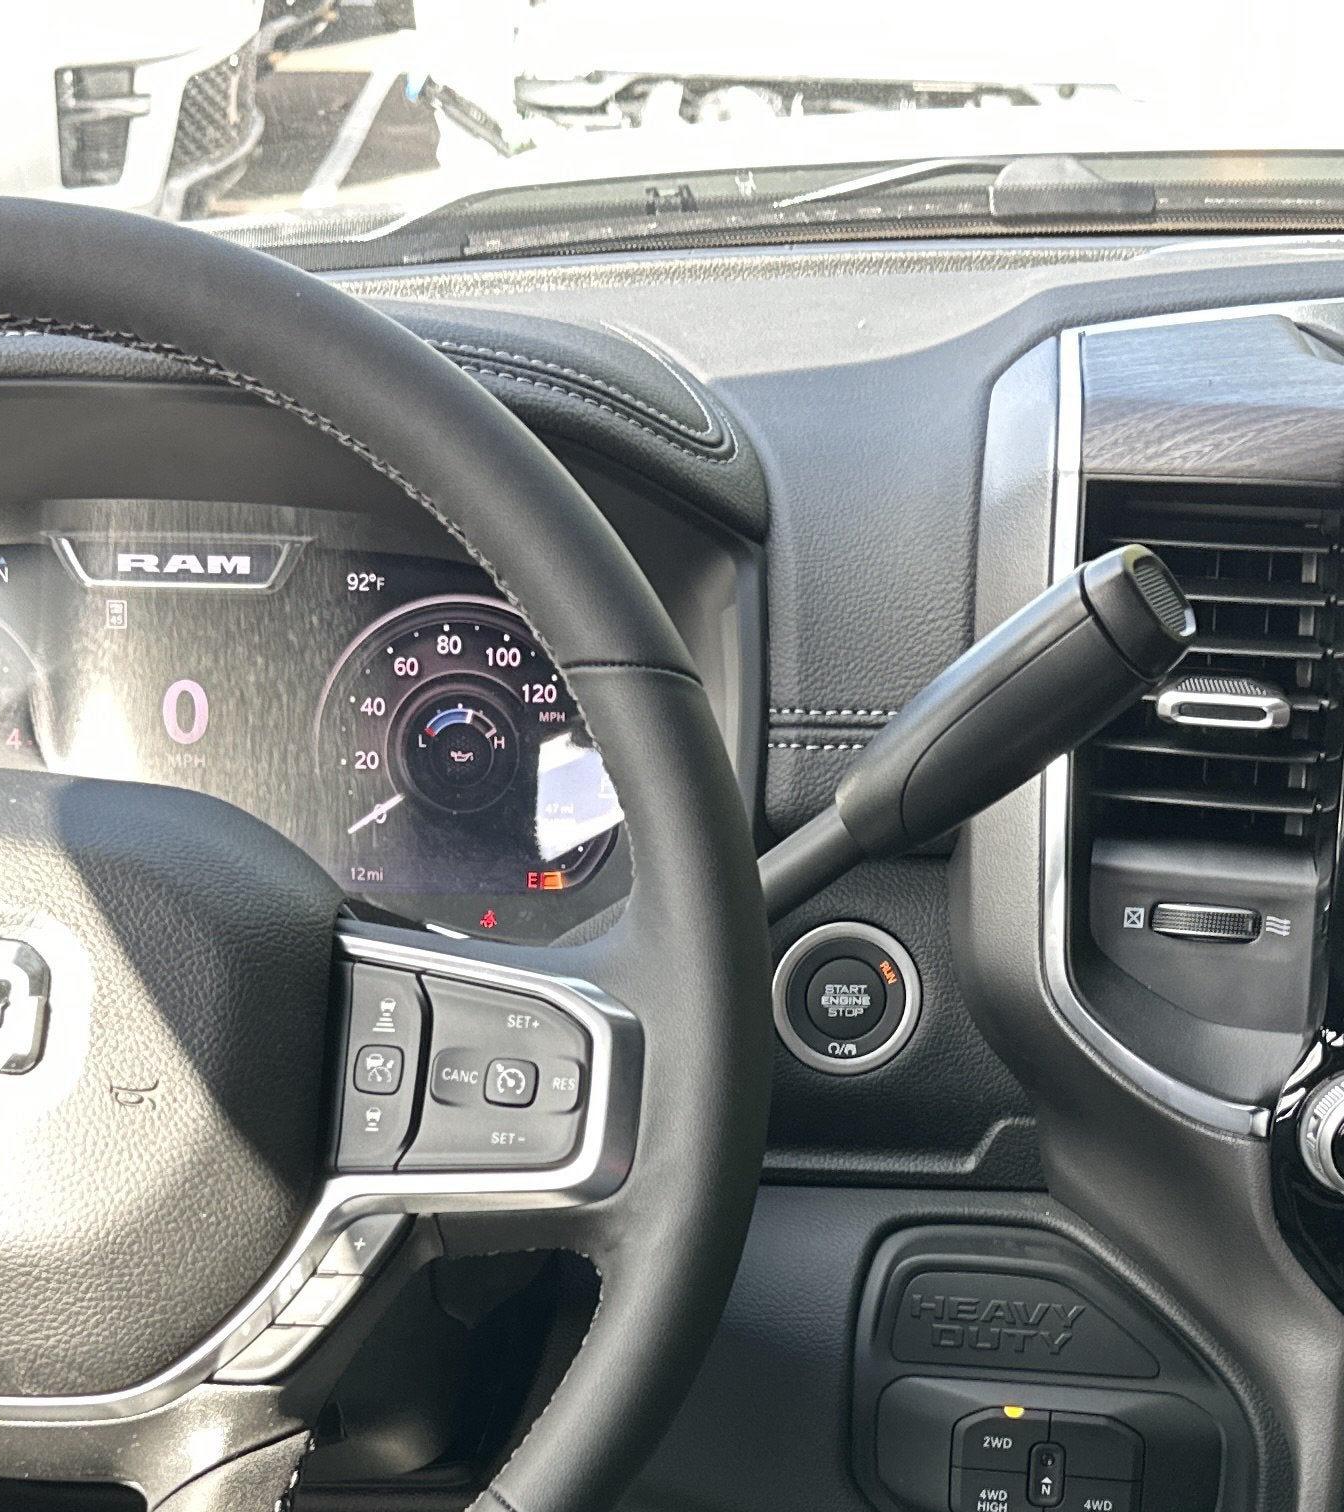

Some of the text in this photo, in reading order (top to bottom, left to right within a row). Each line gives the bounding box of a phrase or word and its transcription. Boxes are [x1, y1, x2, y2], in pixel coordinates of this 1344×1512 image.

[117, 553, 251, 575] RAM
[346, 573, 386, 592] 92°F
[436, 634, 462, 655] 80
[393, 656, 419, 677] 60
[485, 647, 522, 667] 100
[521, 683, 558, 704] 120
[162, 679, 209, 745] 0
[360, 697, 386, 717] 40
[538, 711, 566, 723] MPH
[5, 728, 22, 750] 4
[418, 734, 427, 749] L
[494, 736, 505, 749] H
[354, 750, 379, 770] 20
[879, 960, 898, 985] RUN
[824, 984, 868, 994] START
[821, 994, 871, 1006] ENGINE
[827, 1007, 864, 1018] STOP
[441, 1067, 479, 1085] CANC
[552, 1077, 576, 1092] RES
[910, 1293, 1087, 1329] HEAVY
[930, 1323, 1073, 1355] DUTY
[982, 1435, 1013, 1450] 2WD
[979, 1488, 1008, 1502] 4WD
[1041, 1484, 1052, 1496] N
[1083, 1499, 1113, 1512] 4WD
